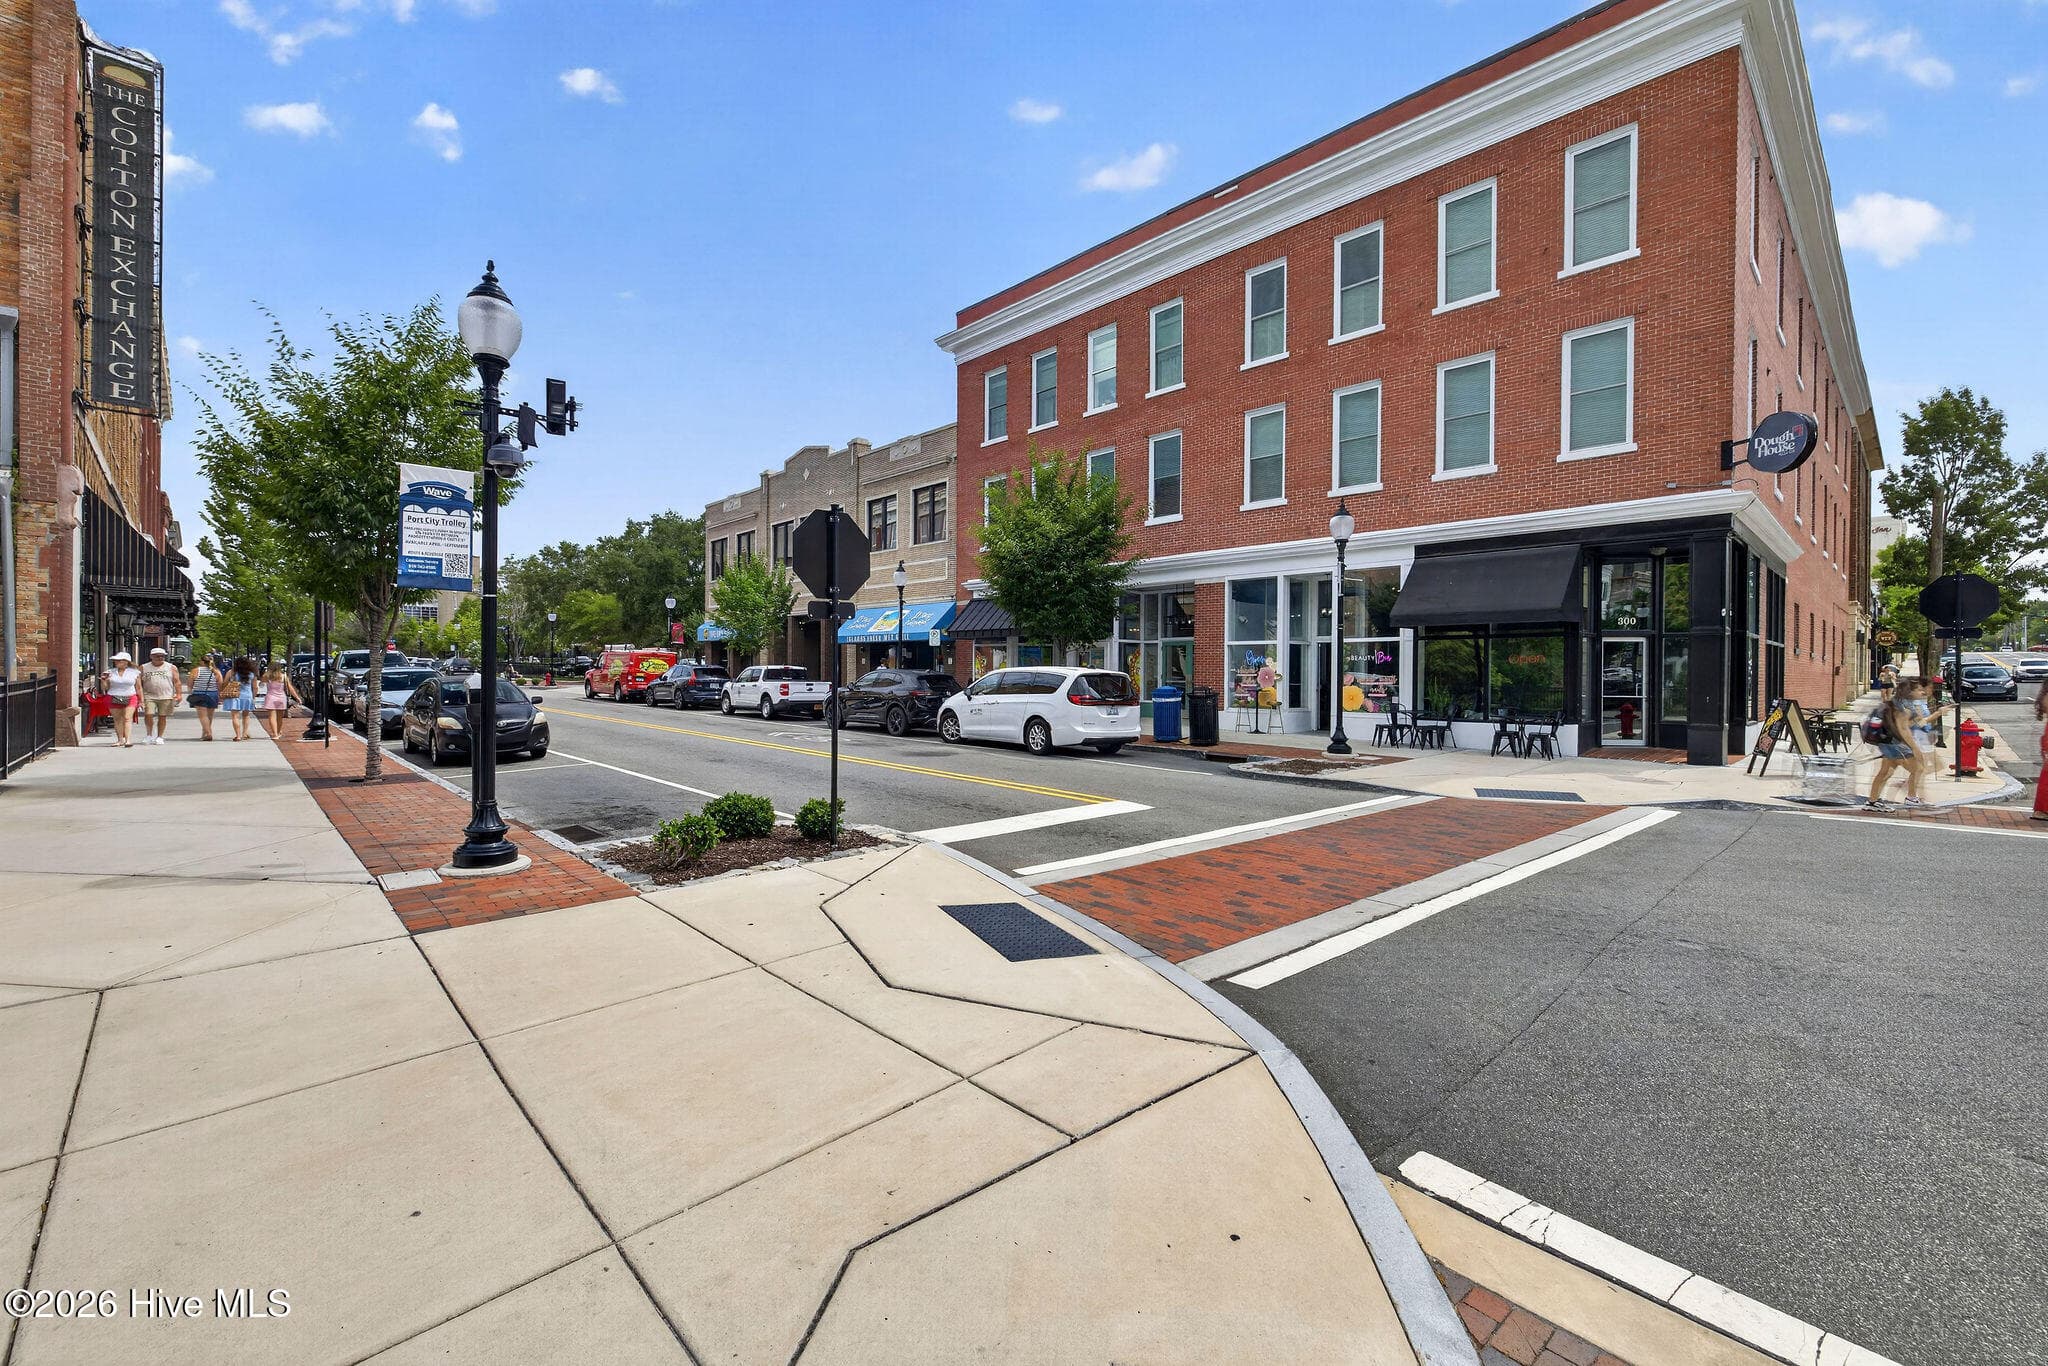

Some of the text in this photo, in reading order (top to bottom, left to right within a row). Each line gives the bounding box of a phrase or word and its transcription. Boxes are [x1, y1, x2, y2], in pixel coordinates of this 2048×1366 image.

[102, 81, 147, 108] THE
[108, 106, 139, 402] COTTON EXCHANGE
[1754, 429, 1796, 450] Dough
[1757, 440, 1797, 458] House
[423, 486, 452, 497] Wave
[408, 516, 466, 528] Port City Trolley
[1617, 617, 1637, 626] 300
